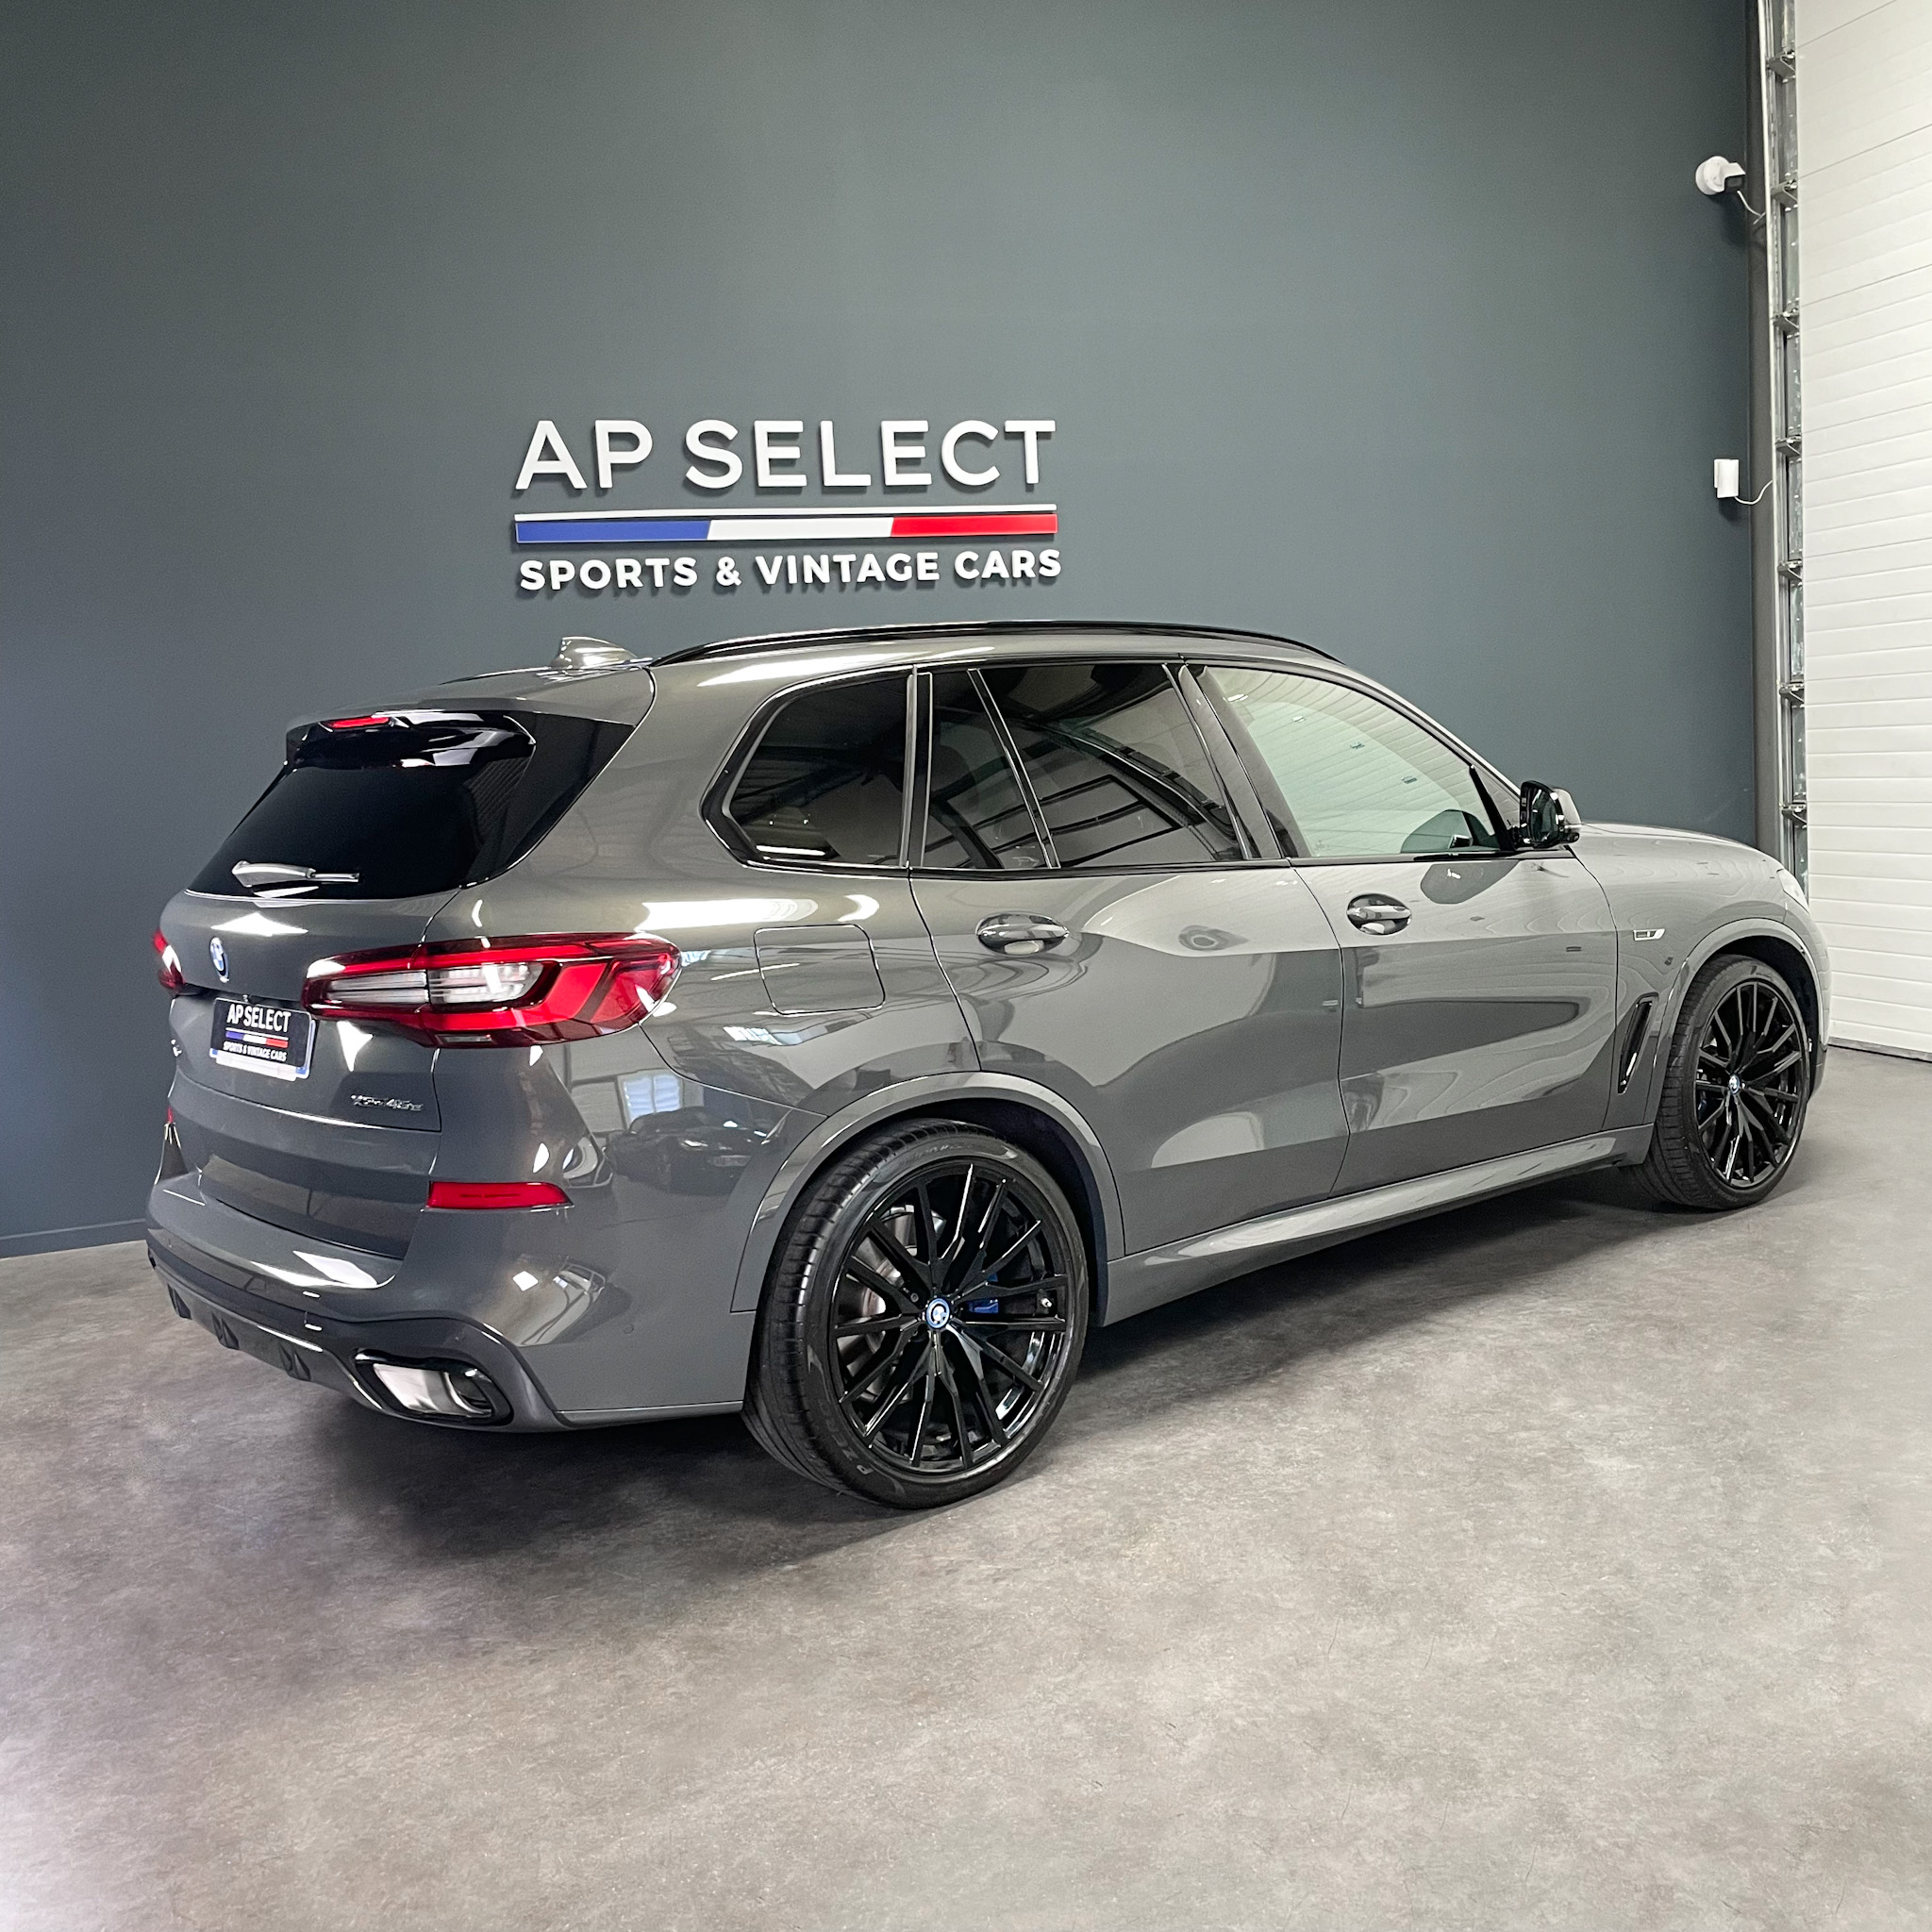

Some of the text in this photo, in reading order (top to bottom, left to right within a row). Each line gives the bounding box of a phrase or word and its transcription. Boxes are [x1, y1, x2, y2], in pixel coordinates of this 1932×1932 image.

[514, 419, 1057, 491] AP SELECT
[520, 548, 1061, 591] SPORTS & VINTAGE CARS
[226, 1004, 291, 1033] AP SELECT
[223, 1041, 243, 1054] SPORTS
[247, 1045, 271, 1059] VINTAGE
[270, 1049, 288, 1062] CARS
